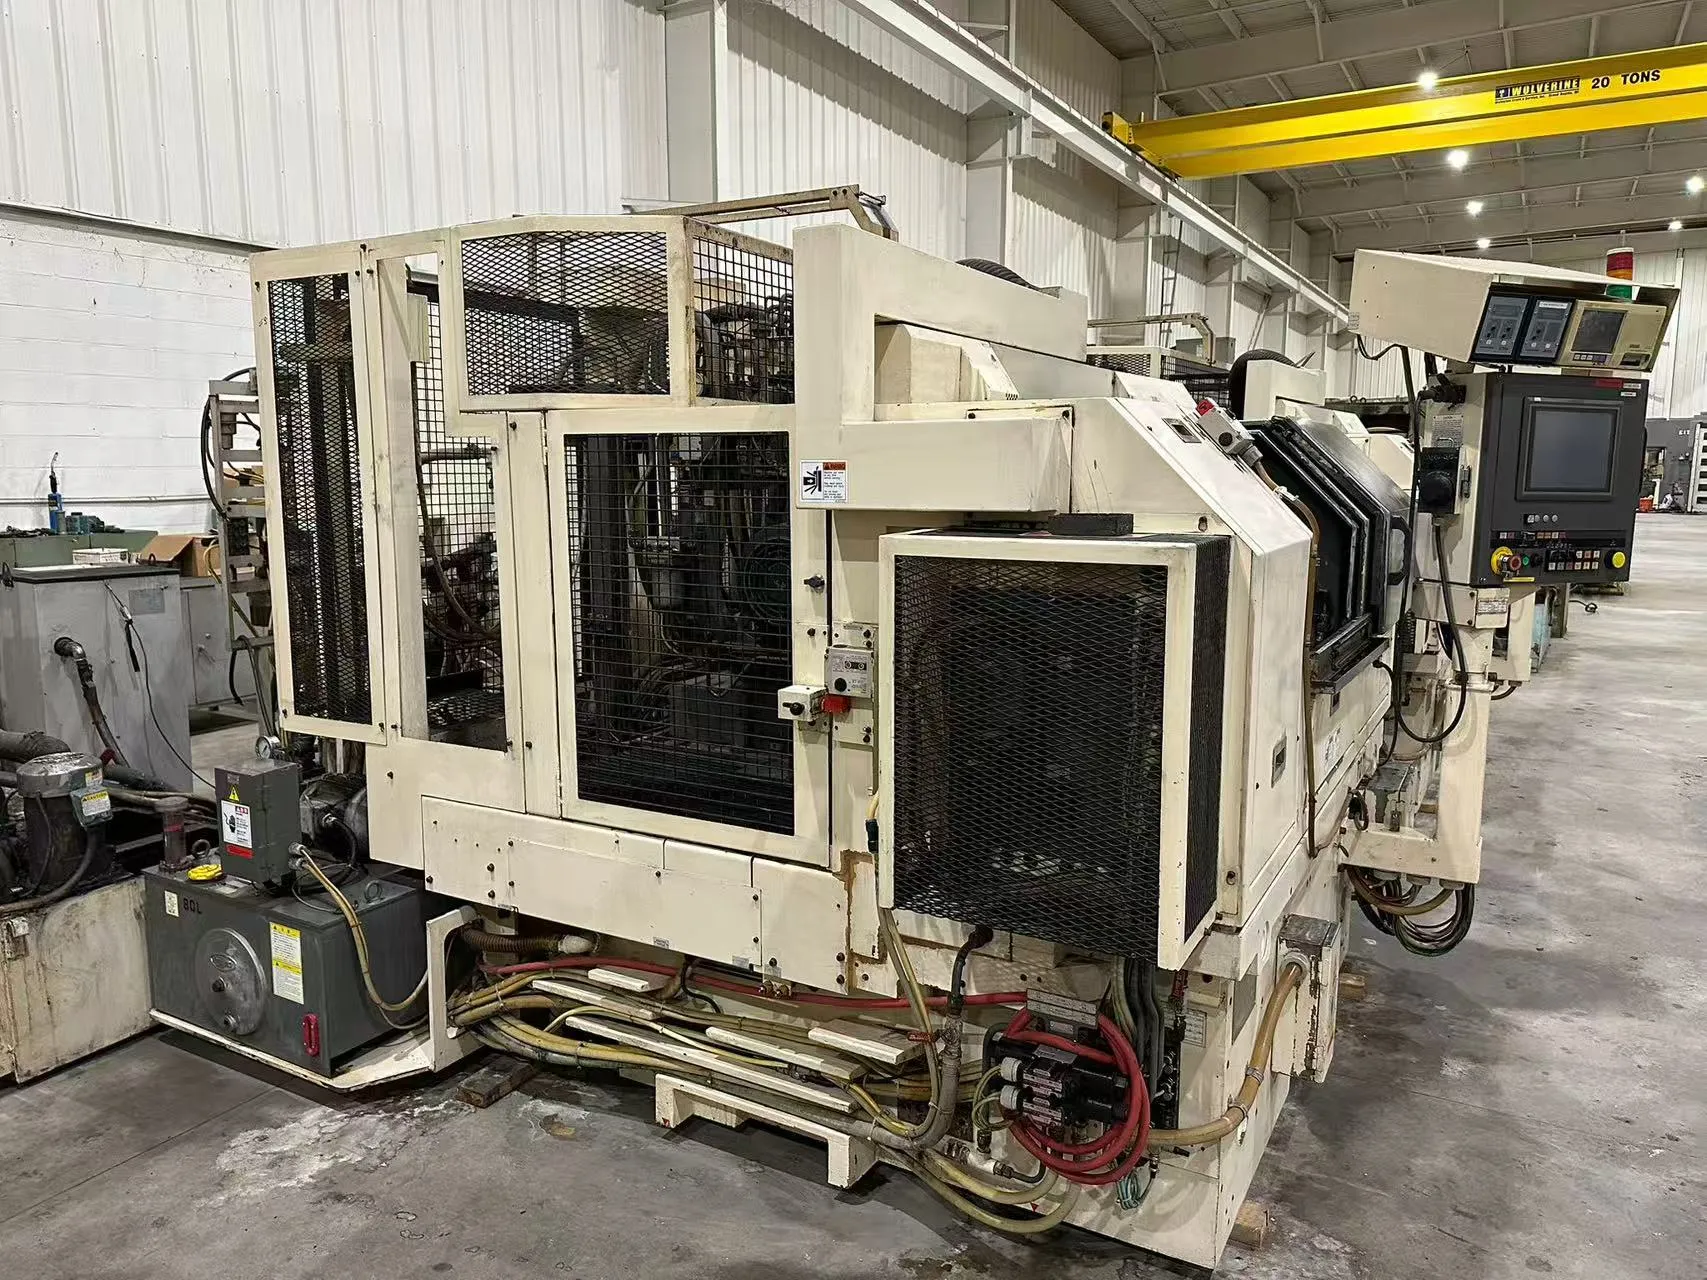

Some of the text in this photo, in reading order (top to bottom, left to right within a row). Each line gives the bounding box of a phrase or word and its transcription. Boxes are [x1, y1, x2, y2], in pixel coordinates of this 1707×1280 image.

[1511, 79, 1579, 97] WOLVERINE
[1591, 76, 1610, 89] 20
[1621, 69, 1661, 85] TONS
